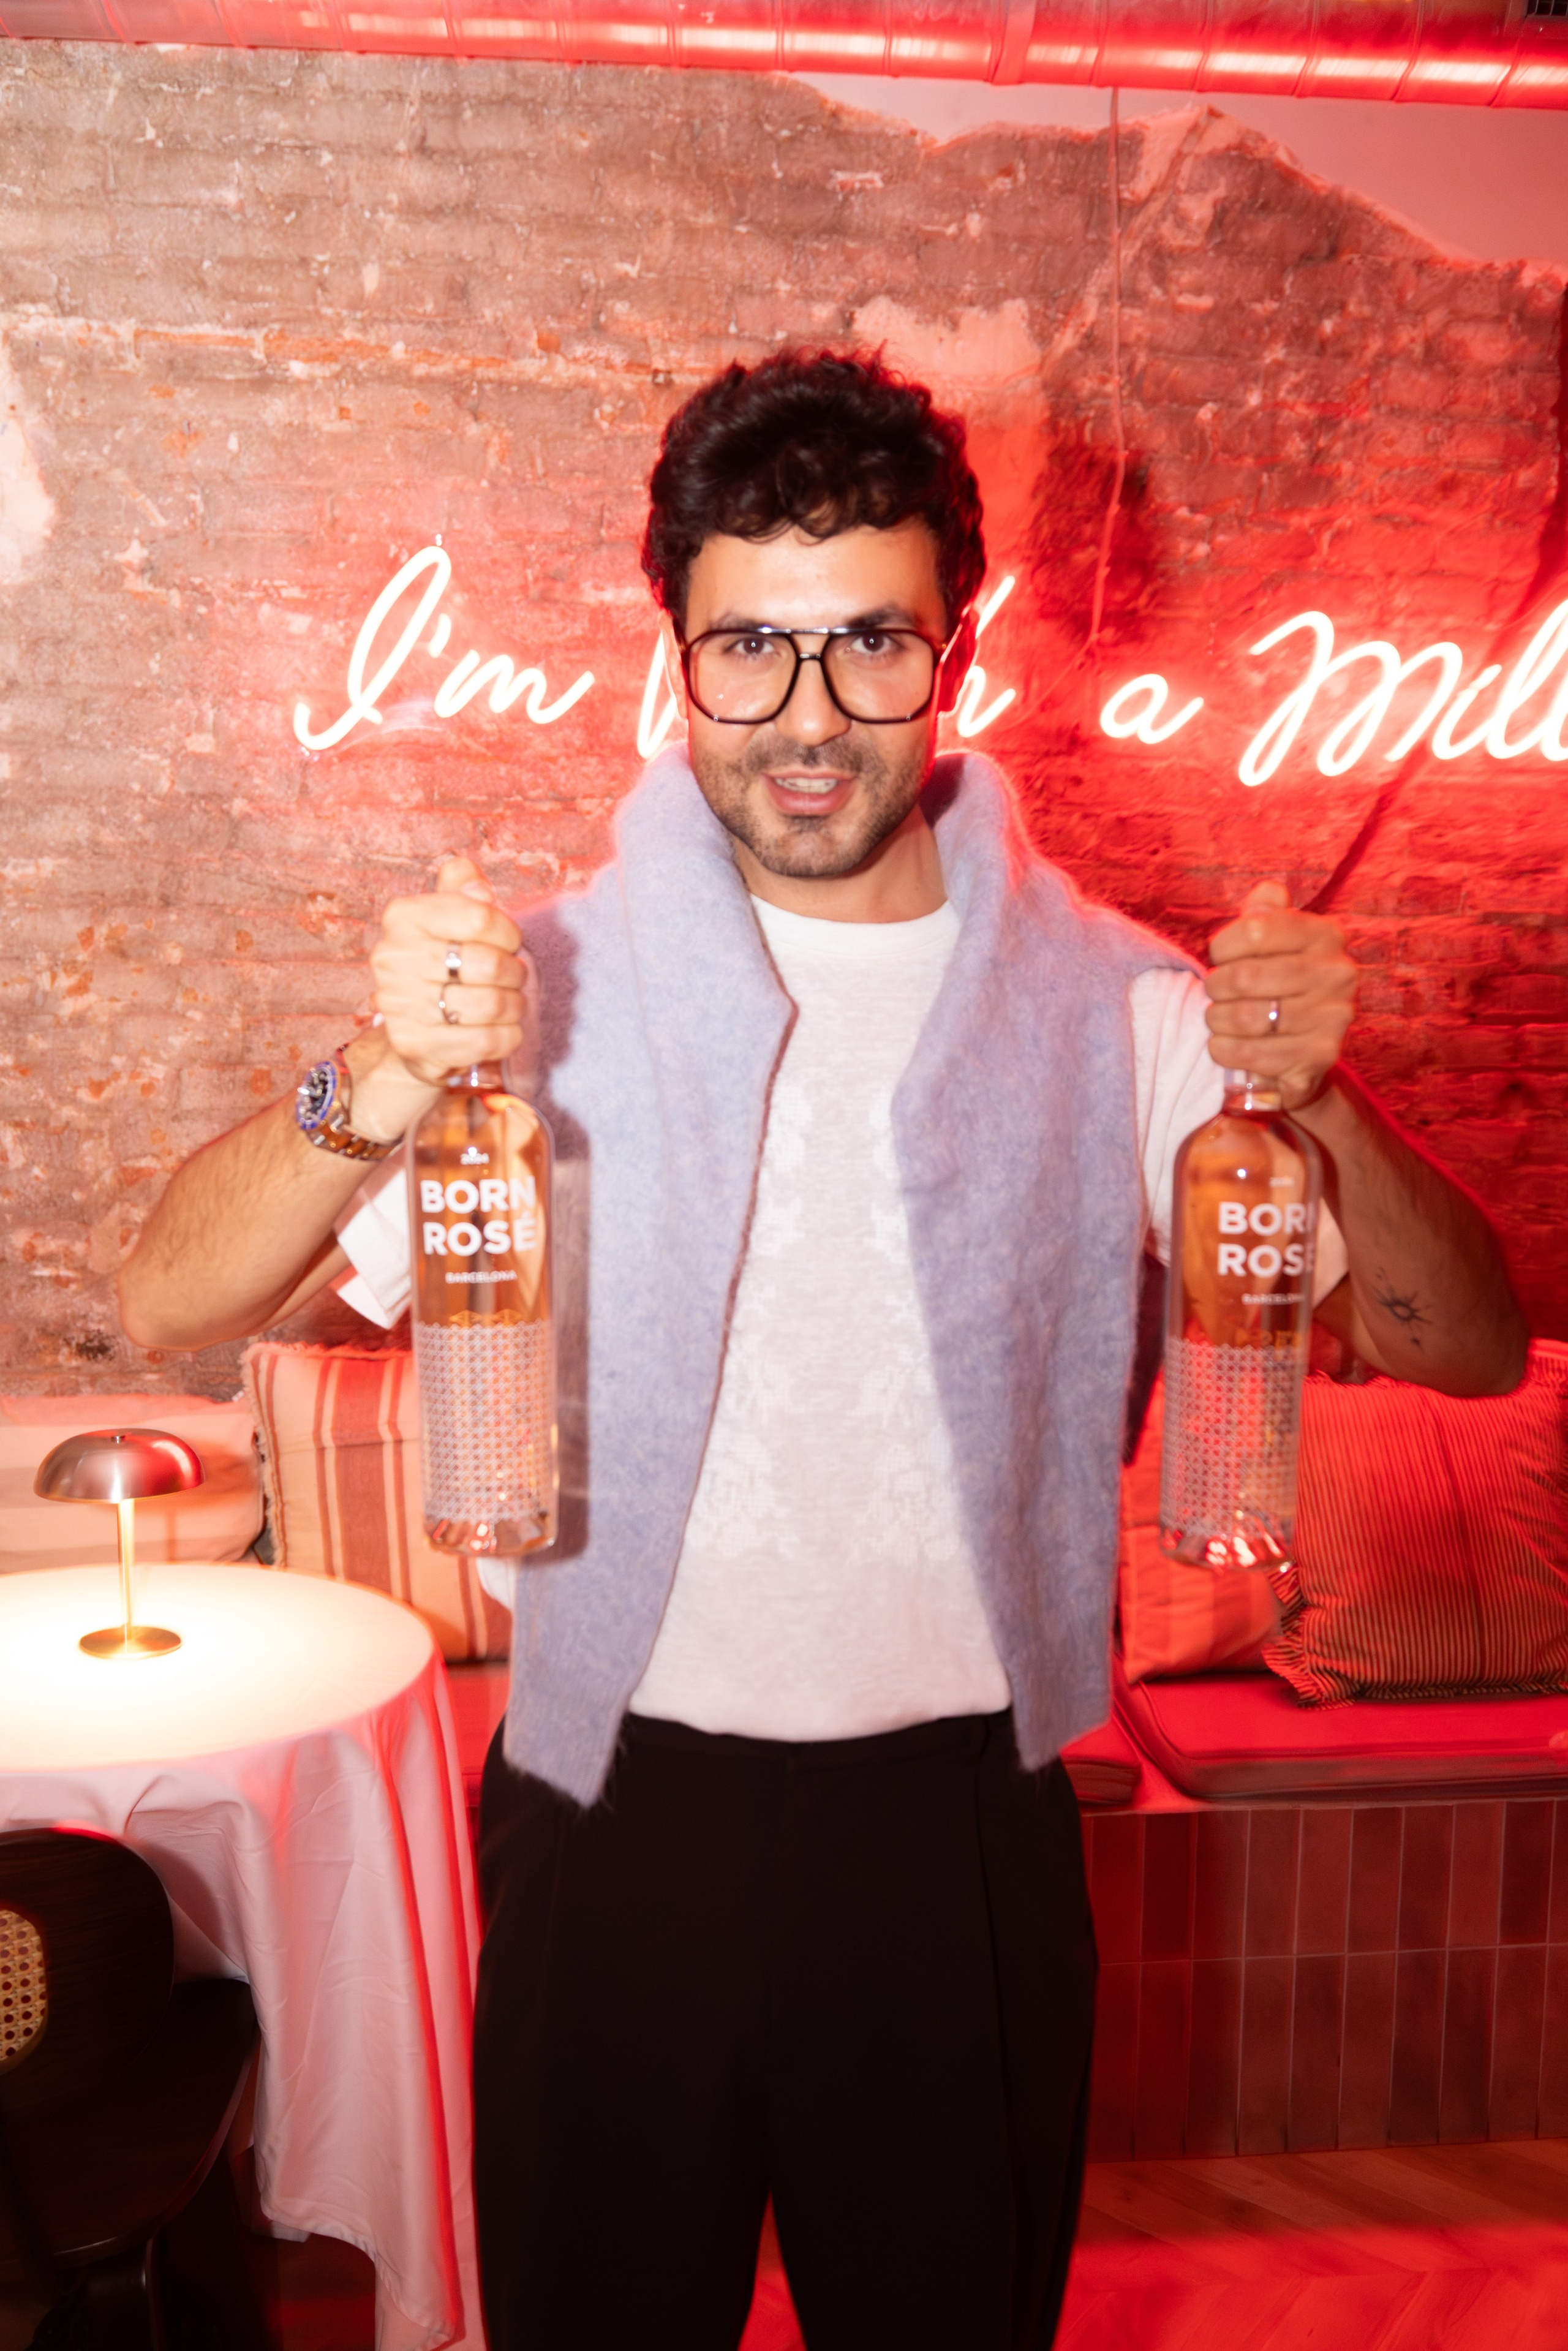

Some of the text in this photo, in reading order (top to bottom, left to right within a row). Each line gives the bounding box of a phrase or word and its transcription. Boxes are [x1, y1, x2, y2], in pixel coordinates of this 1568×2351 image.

[293, 545, 595, 750] I'm
[1100, 674, 1204, 744] a
[420, 1176, 536, 1214] BORN
[423, 1210, 537, 1256] ROSÉ
[445, 1270, 517, 1284] BARCELONA
